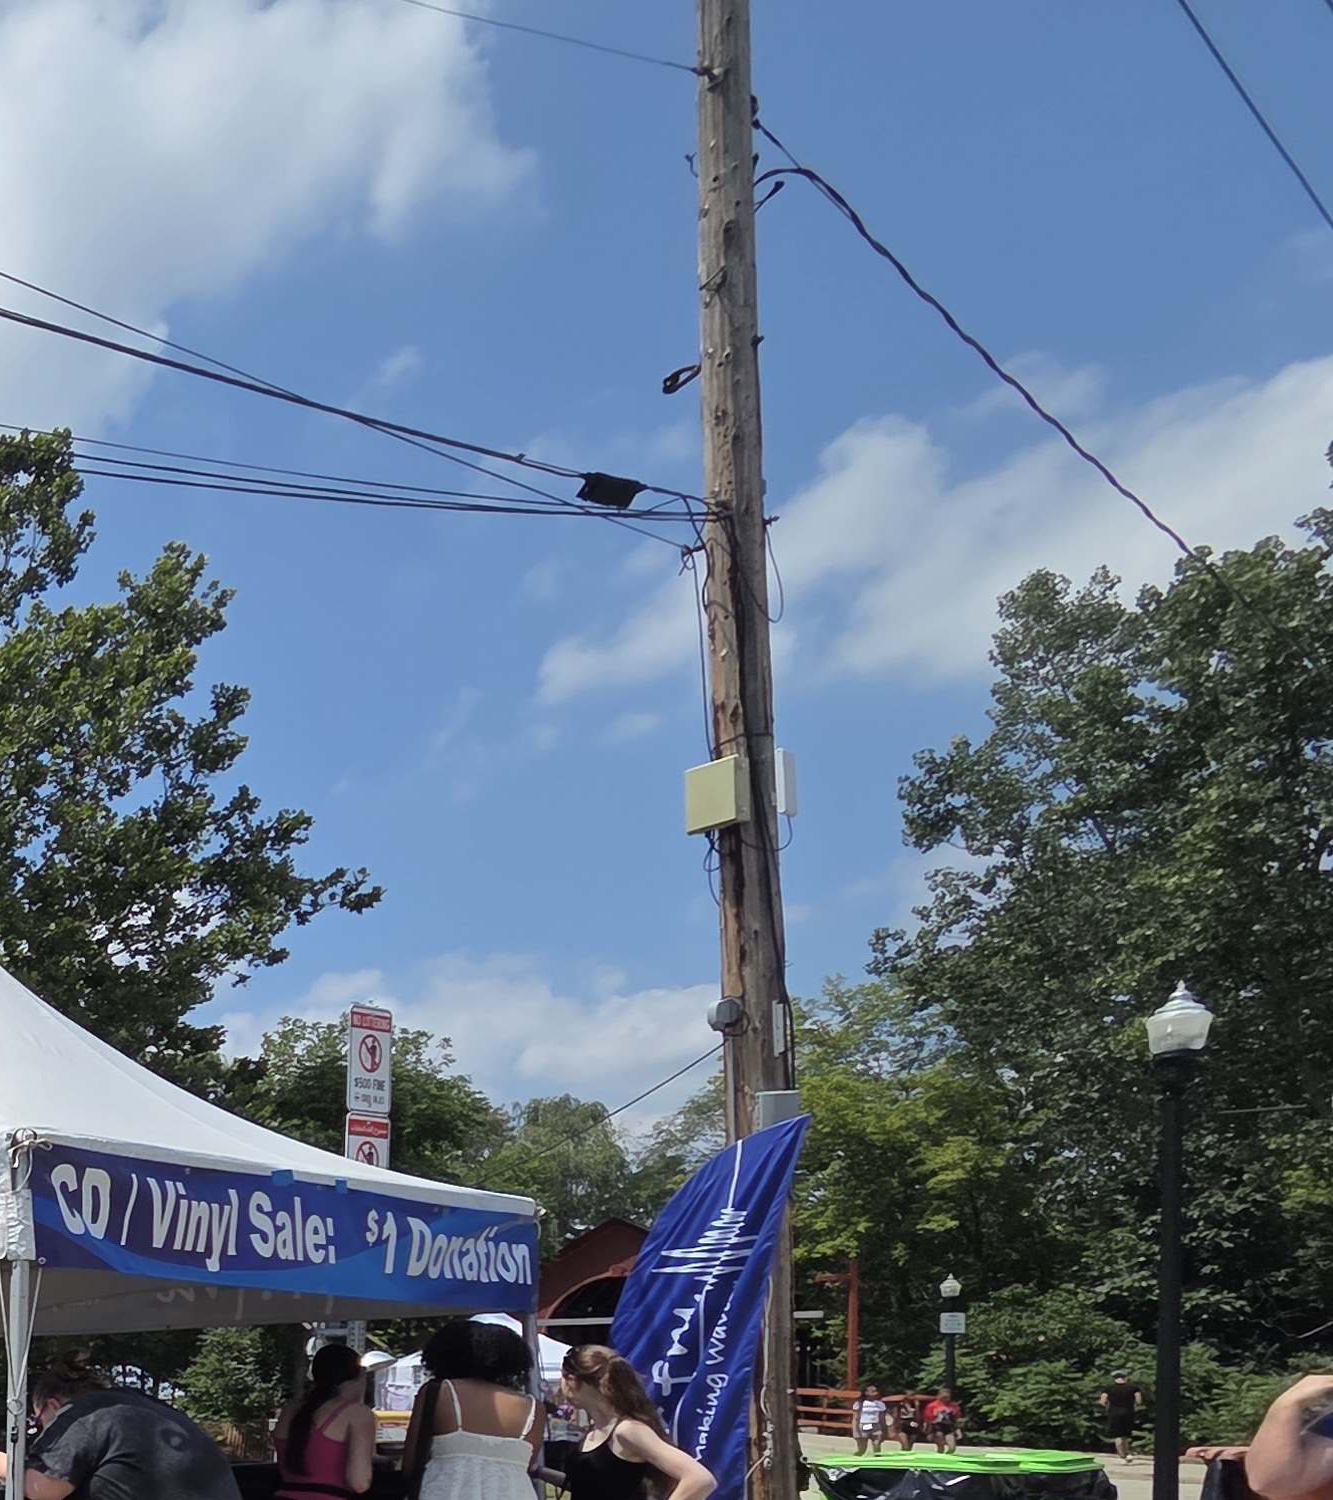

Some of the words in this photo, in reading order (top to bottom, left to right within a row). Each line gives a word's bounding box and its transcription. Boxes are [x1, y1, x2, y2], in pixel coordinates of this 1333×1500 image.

[51, 1163, 111, 1240] CD
[151, 1177, 237, 1272] Vinyl
[249, 1191, 336, 1265] Sale:
[365, 1208, 395, 1275] $1
[406, 1216, 532, 1285] Donation
